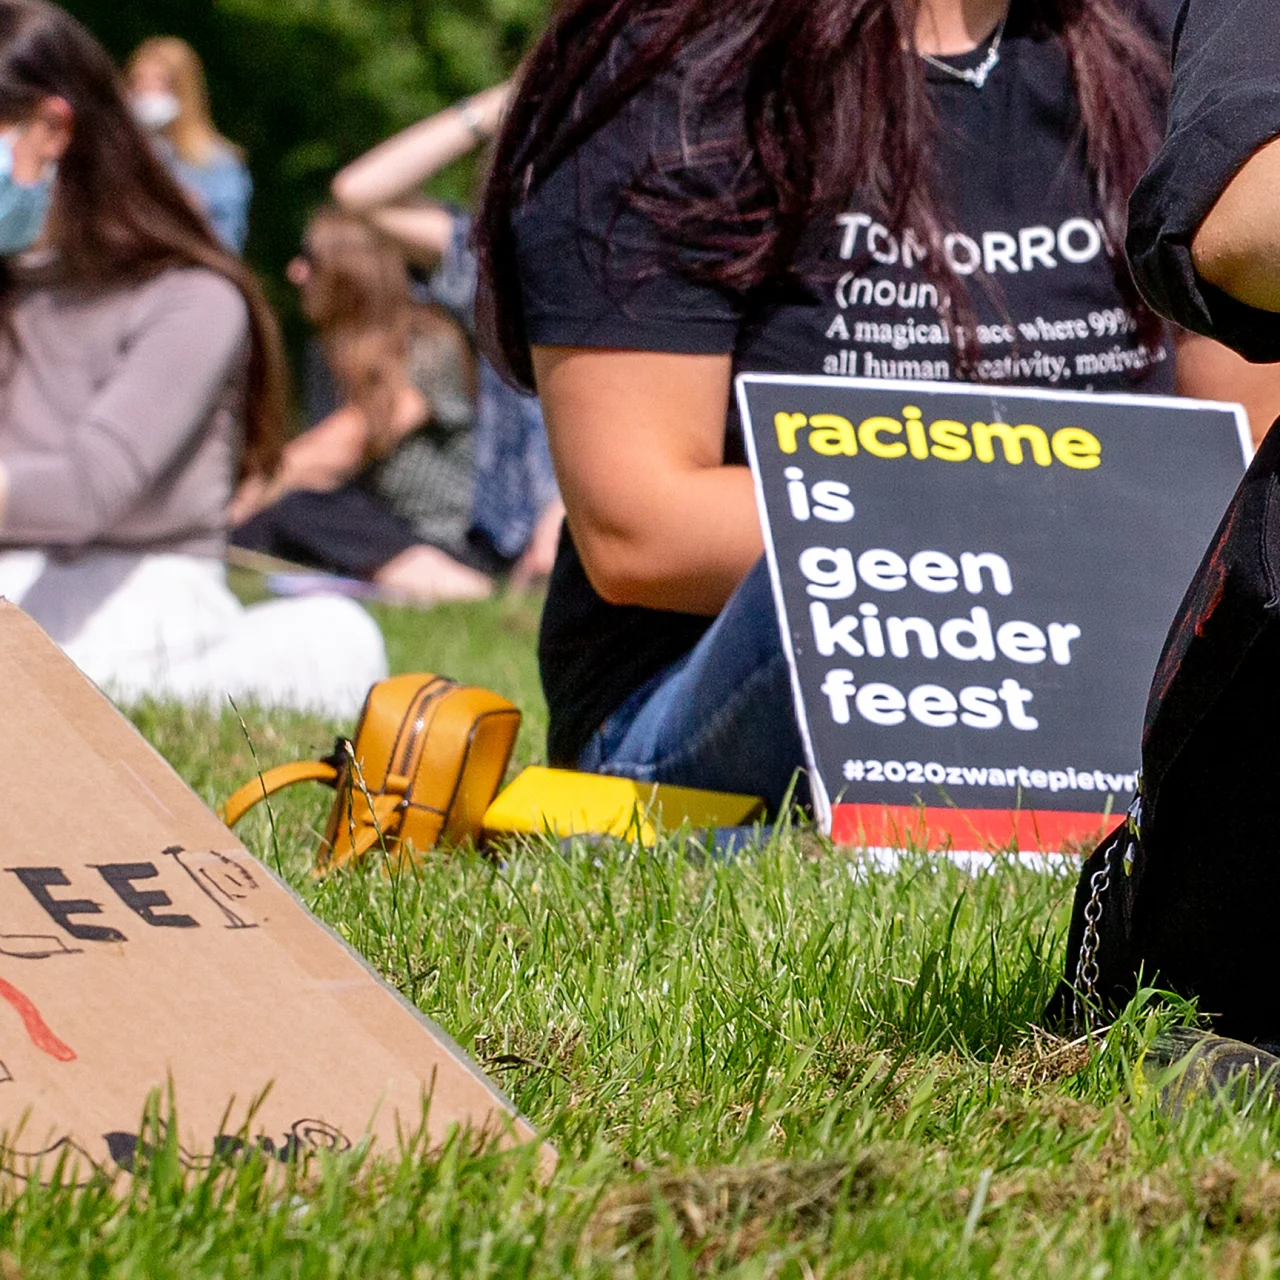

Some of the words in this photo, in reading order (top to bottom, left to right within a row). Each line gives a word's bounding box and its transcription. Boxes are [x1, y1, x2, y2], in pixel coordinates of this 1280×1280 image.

[836, 212, 1115, 276] TOMORRO
[825, 314, 850, 340] A
[853, 317, 950, 350] magical
[1017, 316, 1089, 342] where
[823, 349, 858, 376] all
[863, 351, 950, 380] human
[774, 405, 1102, 469] racisme
[784, 467, 855, 523] is
[799, 545, 1013, 600] geen
[809, 601, 1082, 665] kinder
[821, 669, 1040, 731] feest
